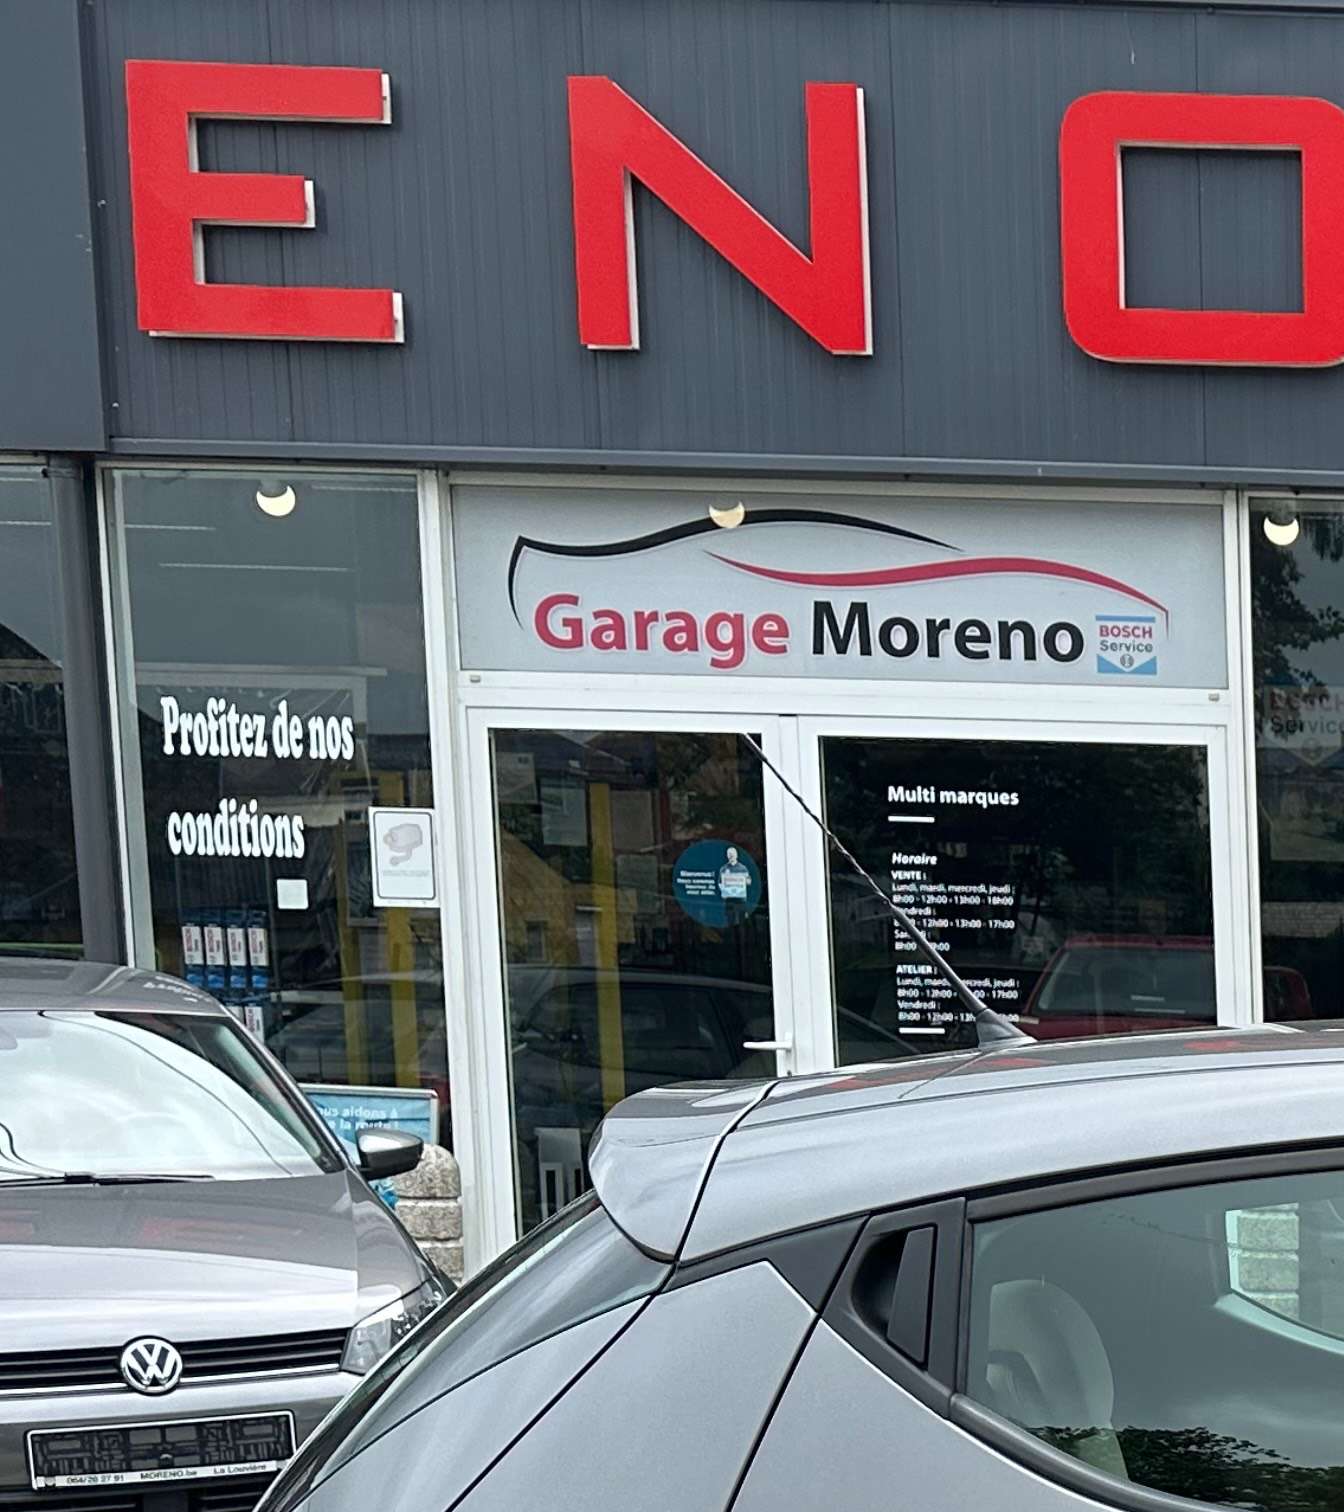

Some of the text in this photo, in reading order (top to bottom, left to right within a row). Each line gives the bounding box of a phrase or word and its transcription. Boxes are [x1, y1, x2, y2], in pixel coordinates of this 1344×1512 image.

[534, 592, 1085, 670] Garage Moreno
[1098, 624, 1153, 639] BOSCH
[1099, 639, 1154, 653] Service
[160, 695, 355, 760] Profitez de nos
[887, 785, 1020, 809] Multi marques
[167, 798, 305, 859] conditions
[891, 852, 938, 866] Horaire
